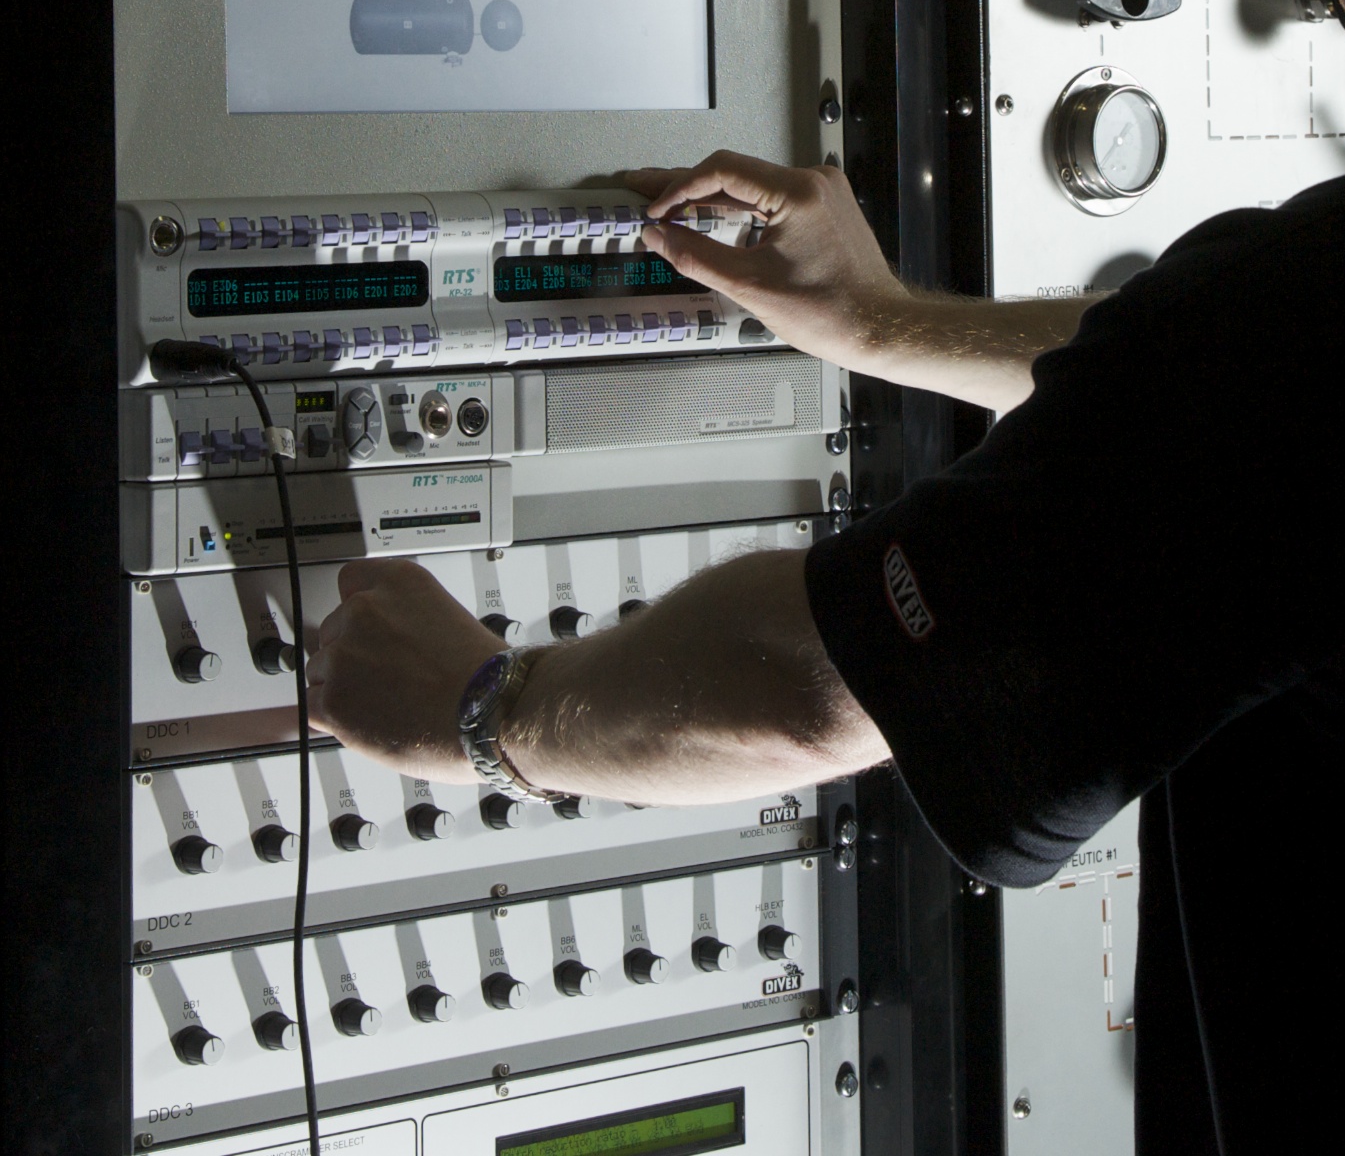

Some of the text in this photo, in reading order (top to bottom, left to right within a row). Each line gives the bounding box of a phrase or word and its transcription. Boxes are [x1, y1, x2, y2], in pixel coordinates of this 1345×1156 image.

[651, 261, 667, 273] TEL
[443, 269, 476, 285] RTS
[449, 288, 473, 297] KP-32
[1037, 285, 1080, 298] OXYGEN
[436, 380, 487, 393] RTS MKP-4
[412, 474, 484, 487] RTS TIF-2000A
[627, 576, 638, 585] ML
[556, 582, 572, 592] BB6
[625, 585, 641, 594] VOL
[888, 552, 928, 632] DIVEX
[485, 590, 501, 599] BB5
[556, 592, 572, 601] VOL
[485, 599, 502, 609] VOL
[146, 721, 190, 740] DDC 1
[339, 789, 356, 800] BB3
[414, 789, 431, 799] VOL
[261, 799, 279, 810] BB2
[339, 798, 356, 809] VOL
[182, 810, 200, 821] BB1
[261, 809, 279, 820] VOL
[763, 806, 797, 824] DIVEX
[182, 820, 200, 831] VOL
[740, 829, 766, 839] MODEL
[1062, 848, 1117, 869] PEUTIC #1
[755, 899, 785, 913] HLB EXT
[700, 913, 709, 923] EL
[763, 910, 778, 920] VOL
[147, 912, 193, 932] DDC 2
[697, 921, 713, 932] VOL
[631, 925, 643, 934] ML
[560, 935, 576, 946] BB6
[630, 933, 646, 943] VOL
[489, 948, 505, 958] BB5
[560, 944, 577, 955] VOL
[416, 960, 432, 971] BB4
[489, 957, 506, 967] VOL
[341, 972, 357, 983] BB3
[416, 970, 433, 981] VOL
[340, 983, 357, 993] VOL
[765, 976, 799, 994] DIVEX
[263, 985, 280, 997] BB2
[183, 1000, 201, 1011] BB1
[263, 996, 281, 1007] VOL
[742, 1000, 768, 1011] MODEL
[183, 1010, 201, 1021] VOL
[148, 1102, 194, 1125] DDC 3
[333, 1136, 366, 1151] SELECT
